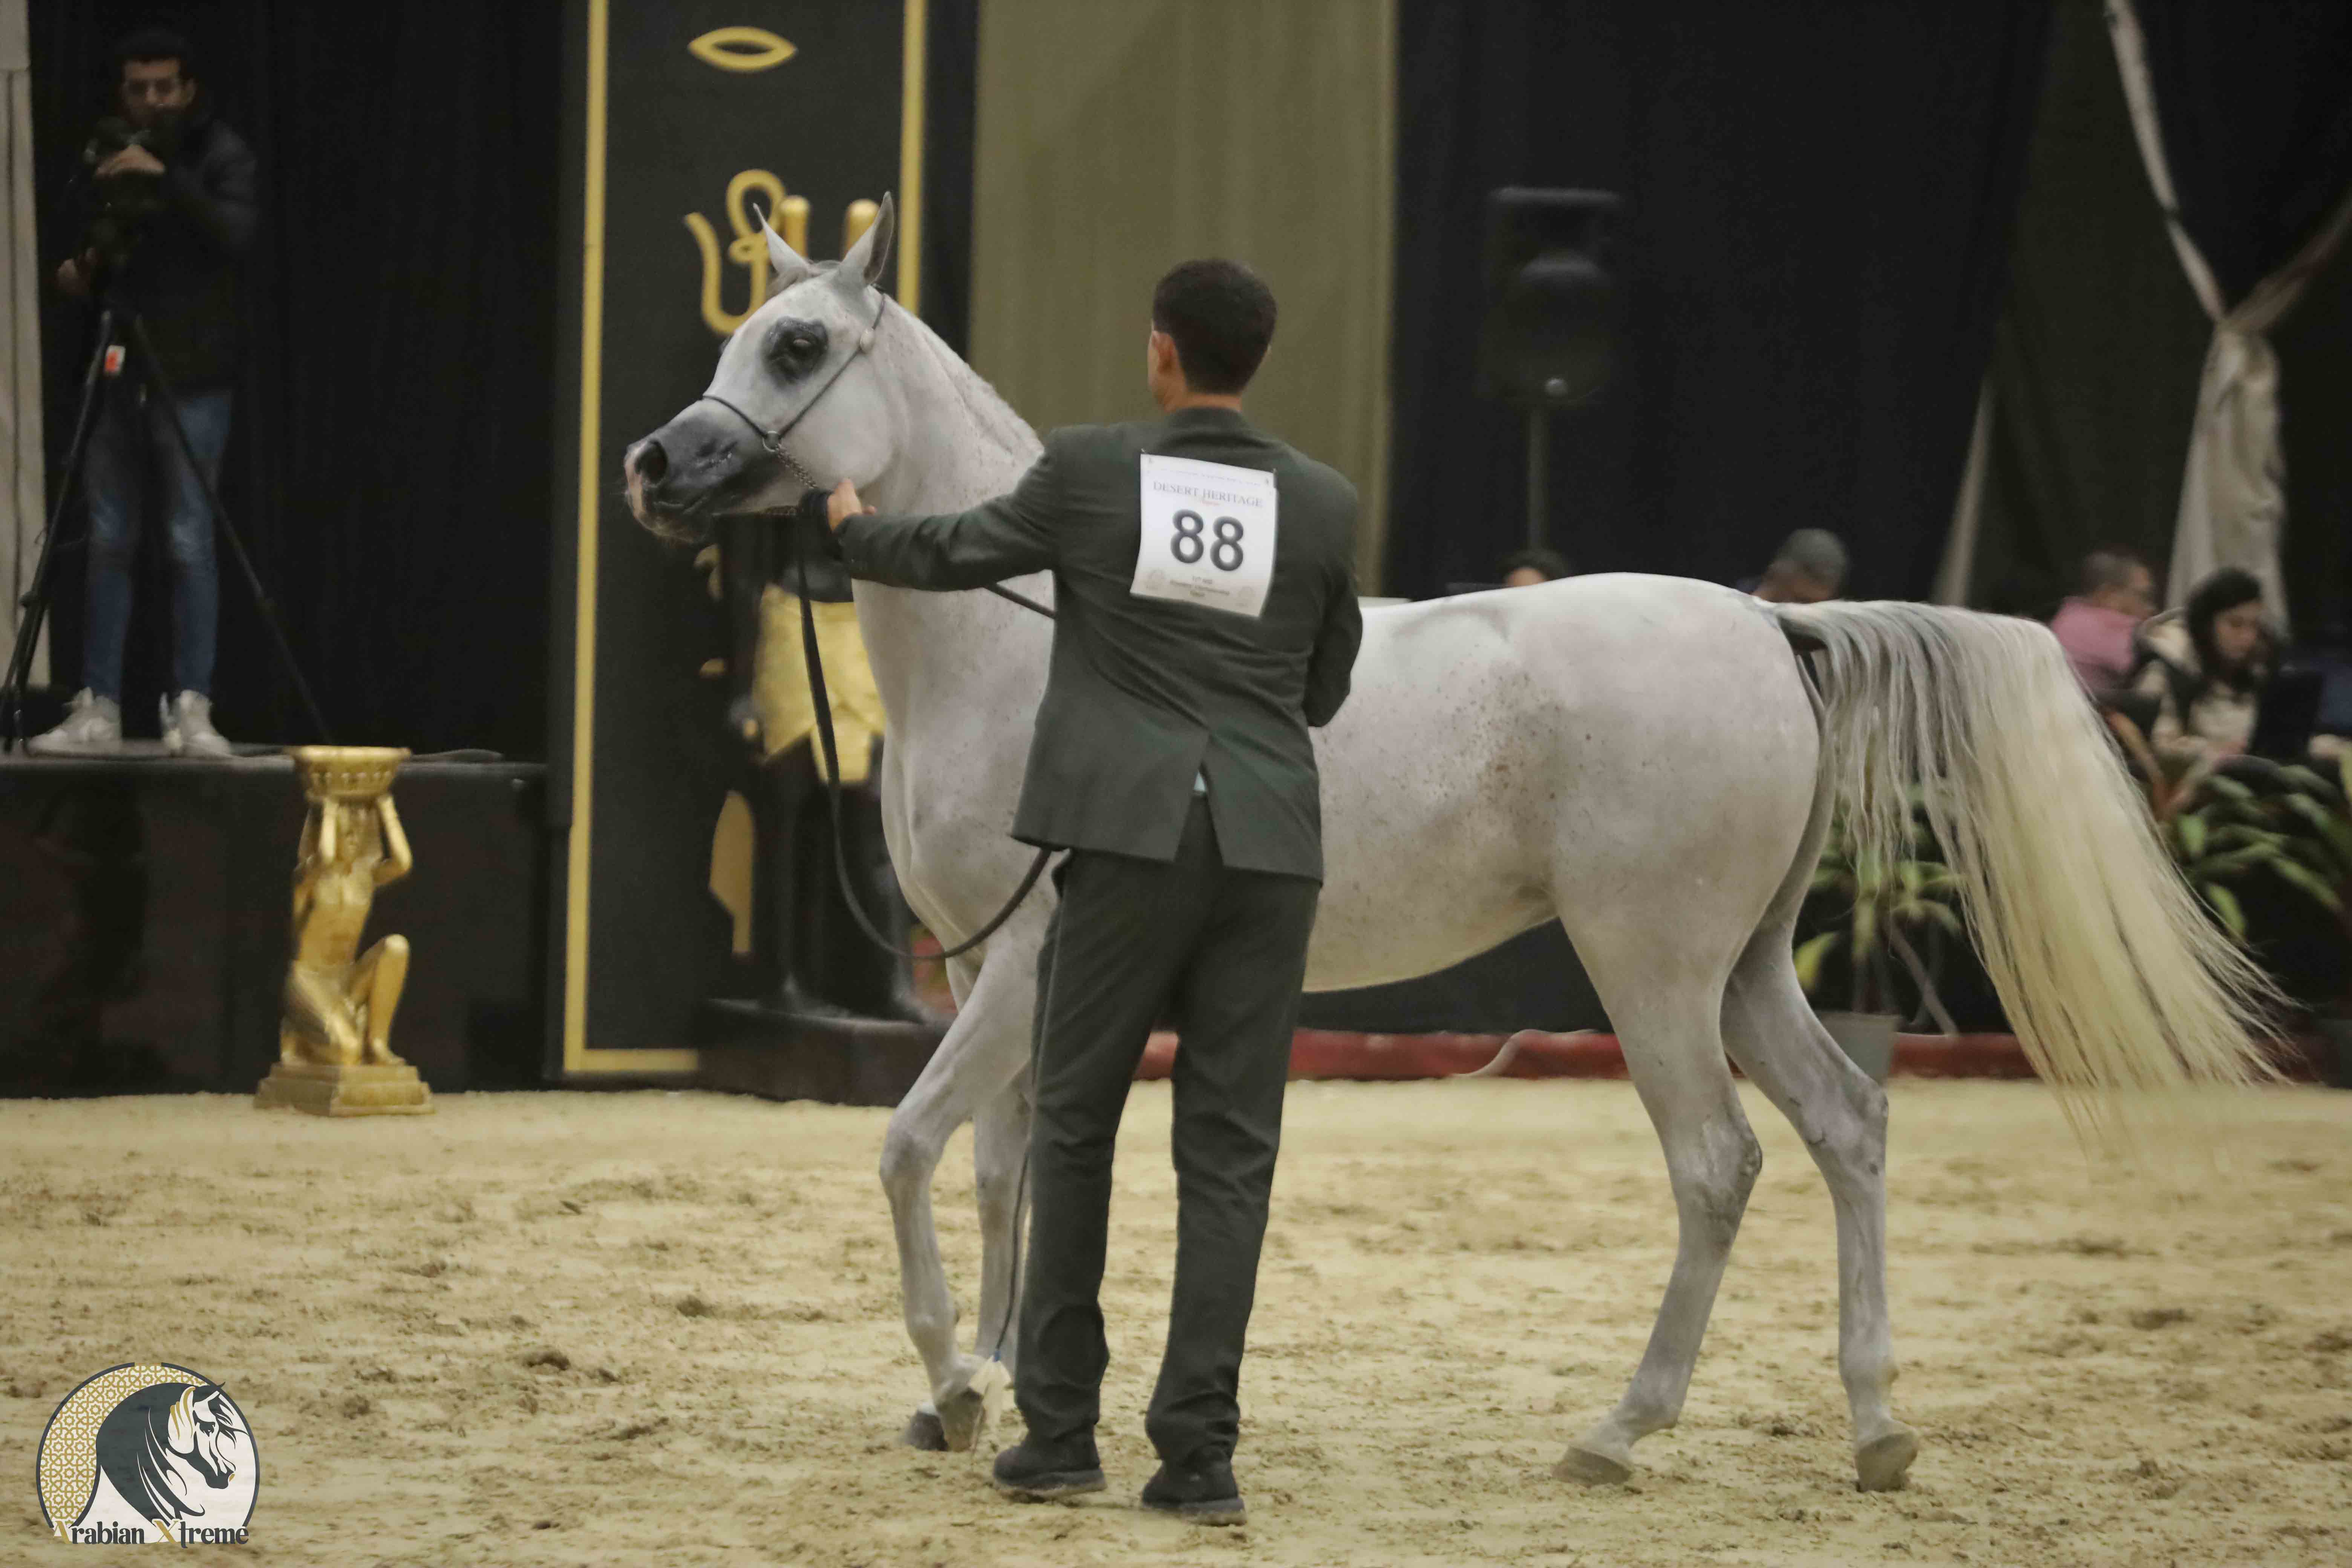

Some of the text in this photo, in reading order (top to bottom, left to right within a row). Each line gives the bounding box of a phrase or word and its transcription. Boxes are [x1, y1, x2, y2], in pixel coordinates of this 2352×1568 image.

[1153, 481, 1263, 508] DESERT HERITAGE
[1170, 509, 1244, 571] 88
